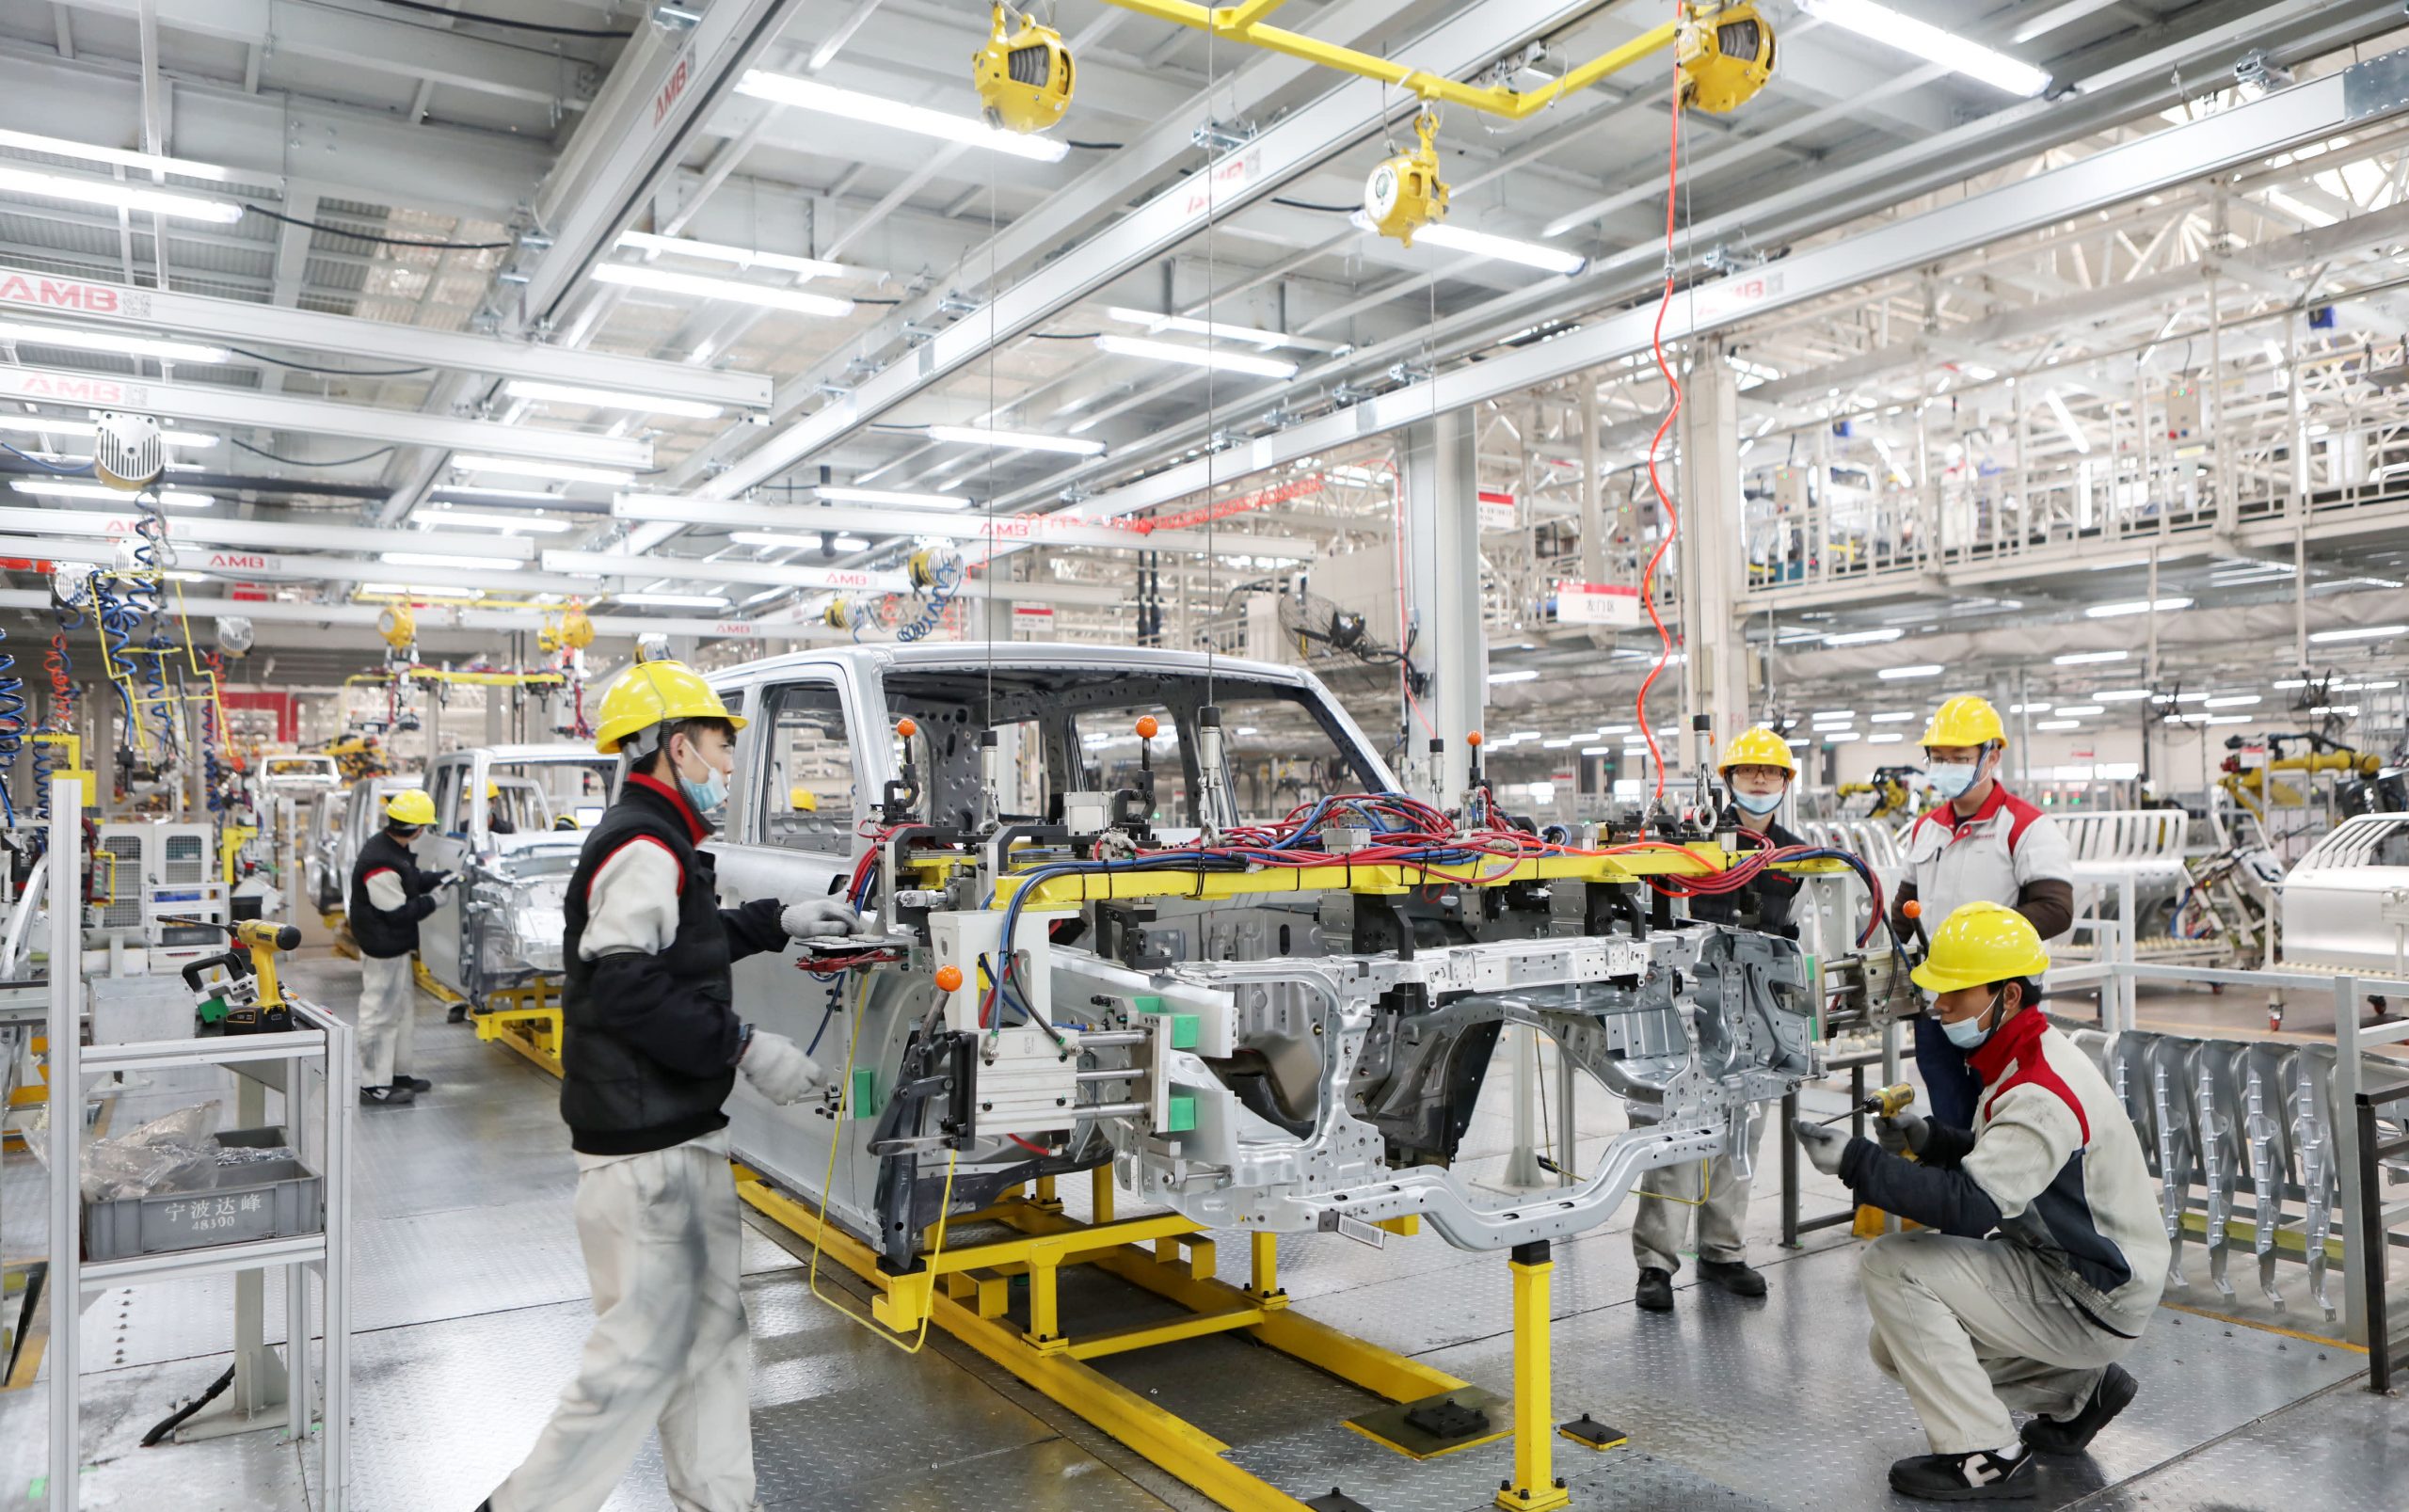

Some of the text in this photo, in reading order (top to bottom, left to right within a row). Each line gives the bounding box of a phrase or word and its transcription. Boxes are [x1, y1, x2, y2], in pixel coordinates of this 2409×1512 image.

[653, 60, 686, 129] AMB
[0, 275, 119, 312] AMB
[22, 372, 121, 403] AMB
[980, 522, 1029, 536] AMB
[210, 554, 264, 568] AMB
[826, 572, 867, 586] AMB
[715, 624, 751, 634] AMB
[165, 1193, 262, 1222] 宁波达峰
